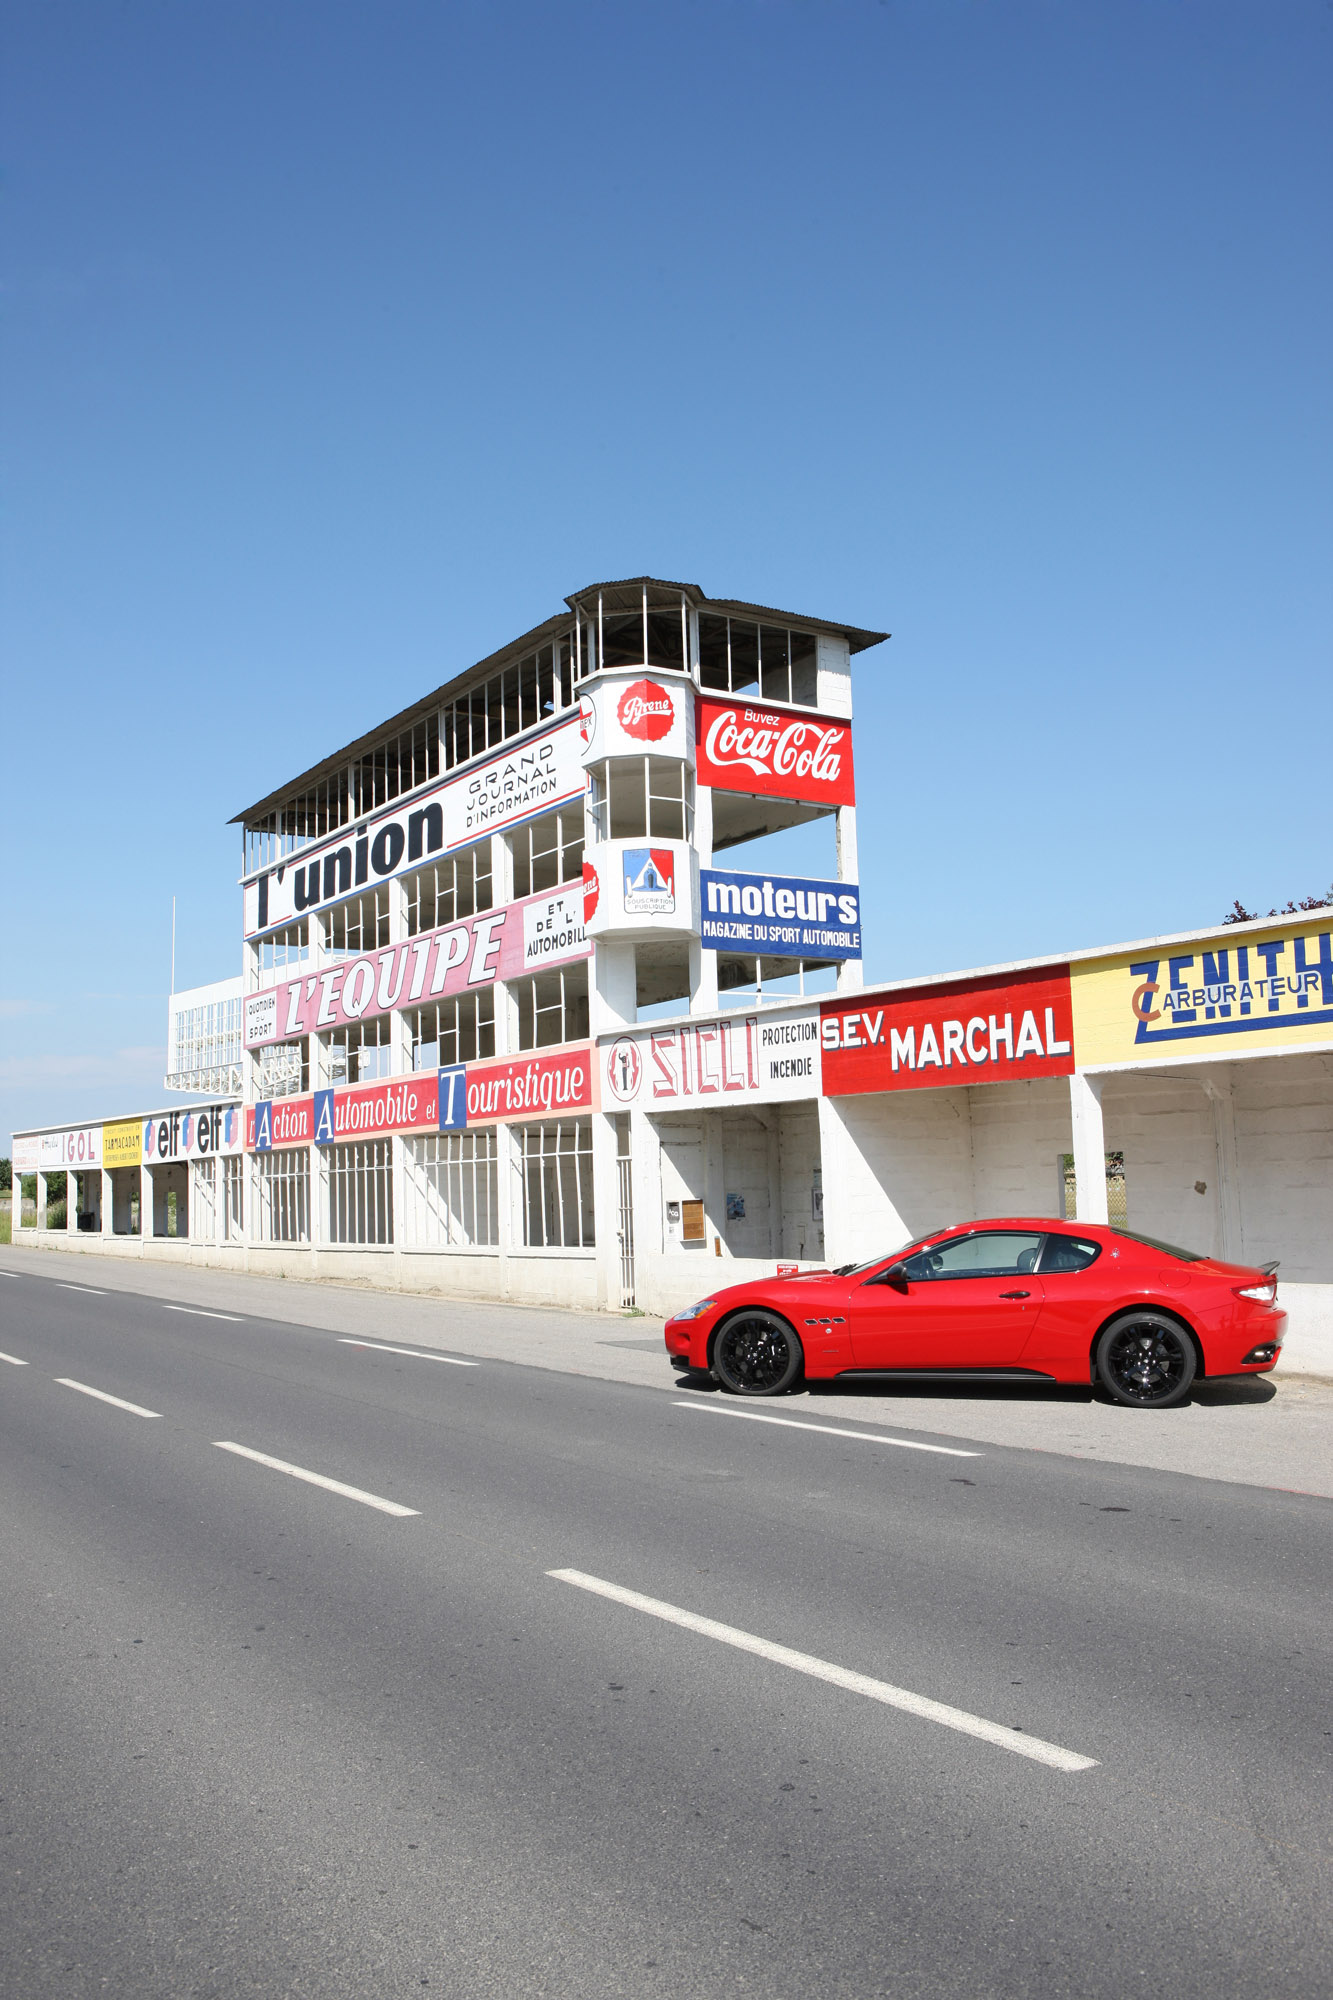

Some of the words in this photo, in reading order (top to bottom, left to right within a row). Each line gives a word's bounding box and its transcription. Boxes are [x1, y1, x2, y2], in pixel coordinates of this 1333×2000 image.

[621, 696, 673, 725] Pyrene
[744, 708, 780, 726] Buvez
[705, 711, 844, 781] Coca-Cola
[467, 763, 556, 811] JOURNAL
[469, 744, 553, 794] GRAND
[467, 777, 556, 828] D'INFORMATION
[258, 802, 443, 930] l'union
[536, 918, 553, 933] DE
[565, 911, 577, 924] L'
[548, 900, 564, 915] ET
[707, 881, 858, 925] moteurs
[703, 920, 752, 940] MAGAZINE
[754, 925, 768, 941] DU
[769, 926, 801, 943] SPORT
[803, 929, 860, 948] AUTOMOBILE
[284, 911, 507, 1035] L'EQUIPE
[1130, 932, 1332, 1044] ZENITH
[249, 997, 276, 1015] QUOTIDIEN
[249, 1022, 272, 1039] SPORT
[762, 1022, 817, 1047] PROTECTION
[821, 1010, 886, 1051] S.E.V.
[890, 1007, 1072, 1072] MARCHAL
[651, 1016, 760, 1098] SICLI
[770, 1057, 813, 1079] INCENDIE
[315, 1084, 418, 1140] Automobile
[426, 1099, 436, 1120] et
[440, 1062, 584, 1125] Touristique
[62, 1131, 95, 1162] IGOL
[105, 1135, 140, 1151] TARMACADAM
[158, 1111, 180, 1158] elf
[197, 1105, 222, 1154] elf
